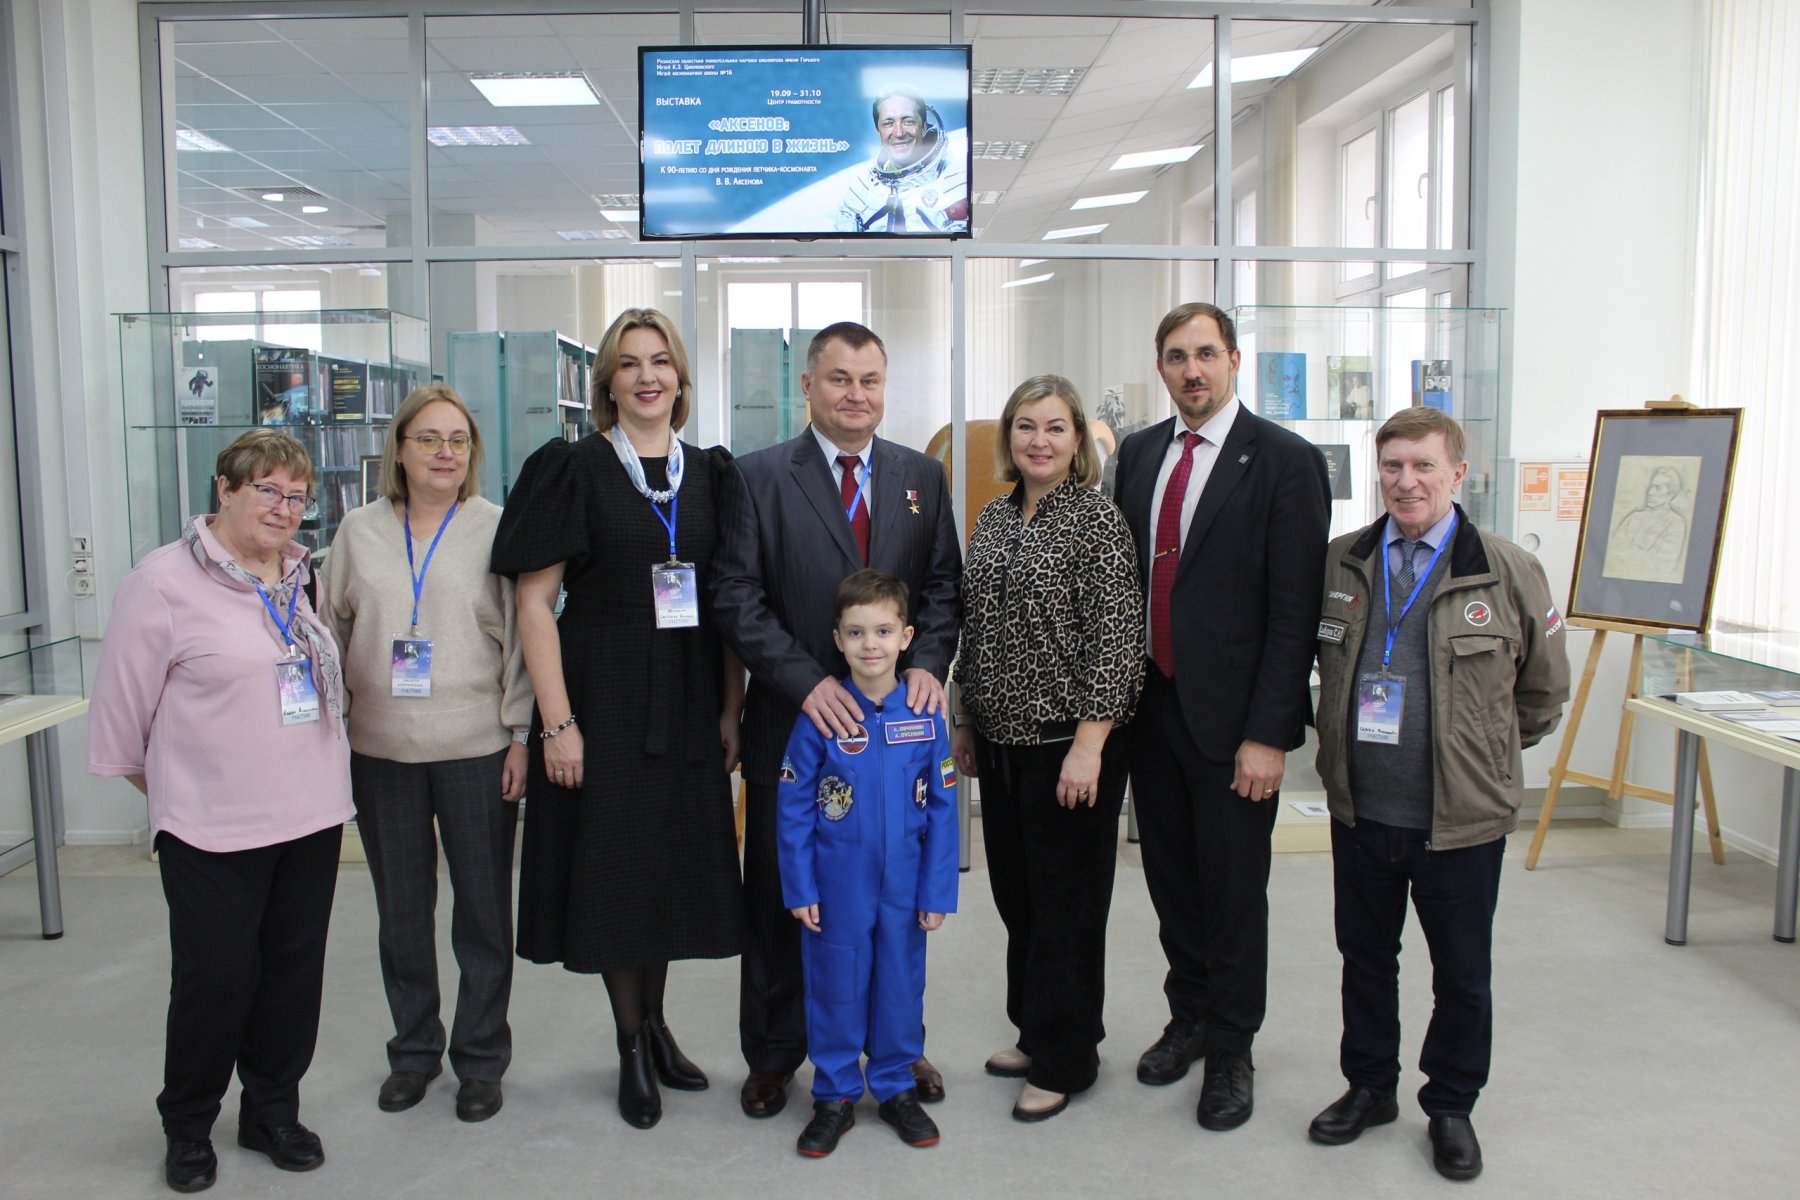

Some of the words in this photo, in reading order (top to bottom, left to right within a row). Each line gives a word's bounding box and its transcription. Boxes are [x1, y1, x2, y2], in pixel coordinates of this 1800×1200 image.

[656, 97, 701, 106] ВЫСТАВКА
[708, 117, 790, 132] «АКСЕНОВ:
[653, 140, 702, 154] ПОЛЕТ
[705, 139, 769, 155] ДЛИНОЮ
[772, 139, 783, 153] В
[786, 138, 850, 153] ЖИЗНЬ»
